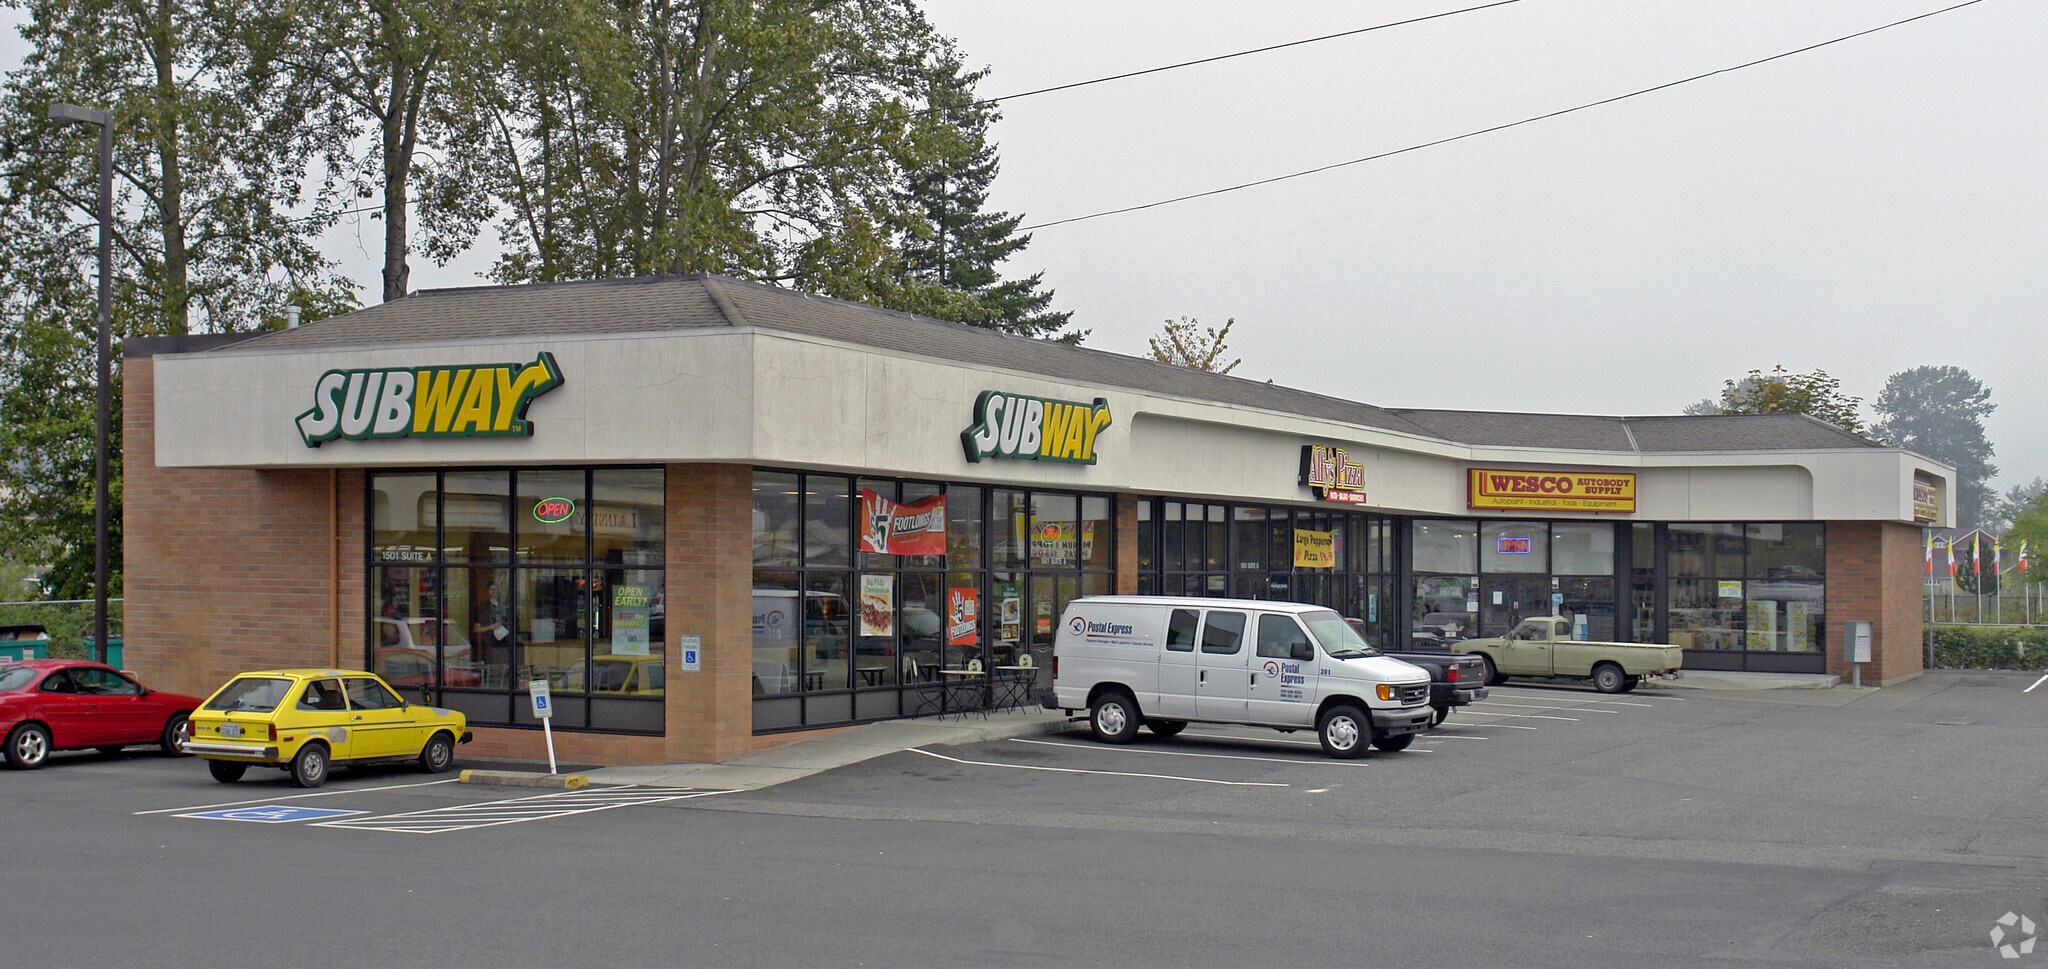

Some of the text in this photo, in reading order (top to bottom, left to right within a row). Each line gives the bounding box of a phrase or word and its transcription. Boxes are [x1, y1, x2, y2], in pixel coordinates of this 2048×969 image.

[298, 359, 551, 441] SUBWAY
[975, 394, 1110, 460] SUBWAY
[1336, 450, 1364, 488] Pizza
[1491, 475, 1573, 494] WESCO
[1577, 478, 1630, 487] AUTOBODY
[1585, 486, 1622, 495] SUPPLY
[1492, 498, 1523, 506] Autopaint
[1562, 499, 1577, 507] Tools
[1583, 500, 1617, 508] Equipment
[537, 502, 569, 517] OPEN
[1499, 540, 1530, 552] OPEN
[382, 551, 432, 561] 1501 SUITE A
[1304, 551, 1318, 561] Pizza
[618, 587, 643, 596] OPEN
[615, 596, 647, 606] EARLY!
[1088, 621, 1133, 635] Postal Express
[1281, 662, 1300, 674] Postal
[1281, 672, 1305, 685] Express
